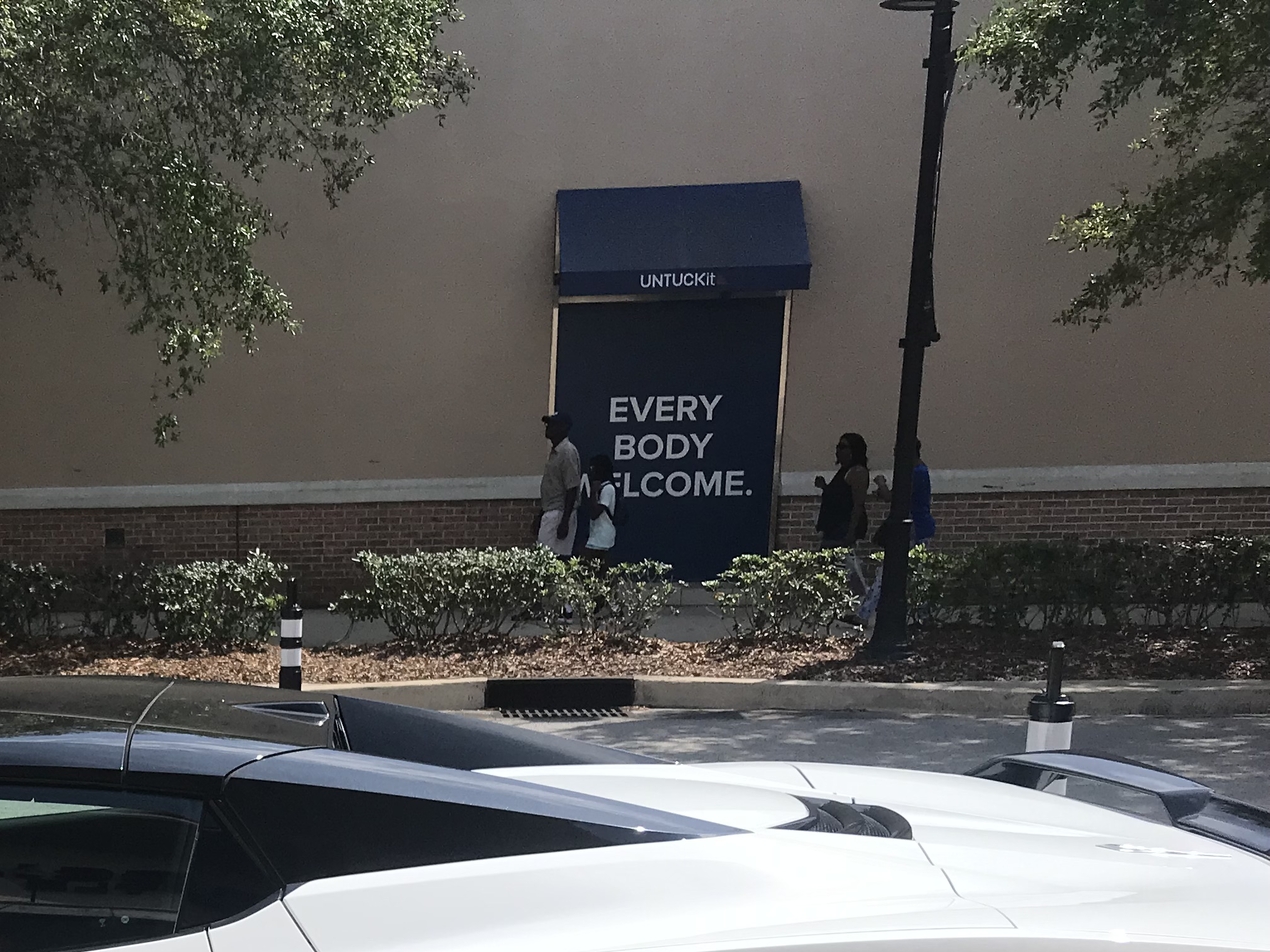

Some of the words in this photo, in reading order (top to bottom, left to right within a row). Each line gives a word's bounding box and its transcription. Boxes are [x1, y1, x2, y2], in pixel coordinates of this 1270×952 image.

[640, 272, 716, 288] UNTUCKit
[609, 394, 723, 423] EVERY
[614, 433, 714, 461] BODY
